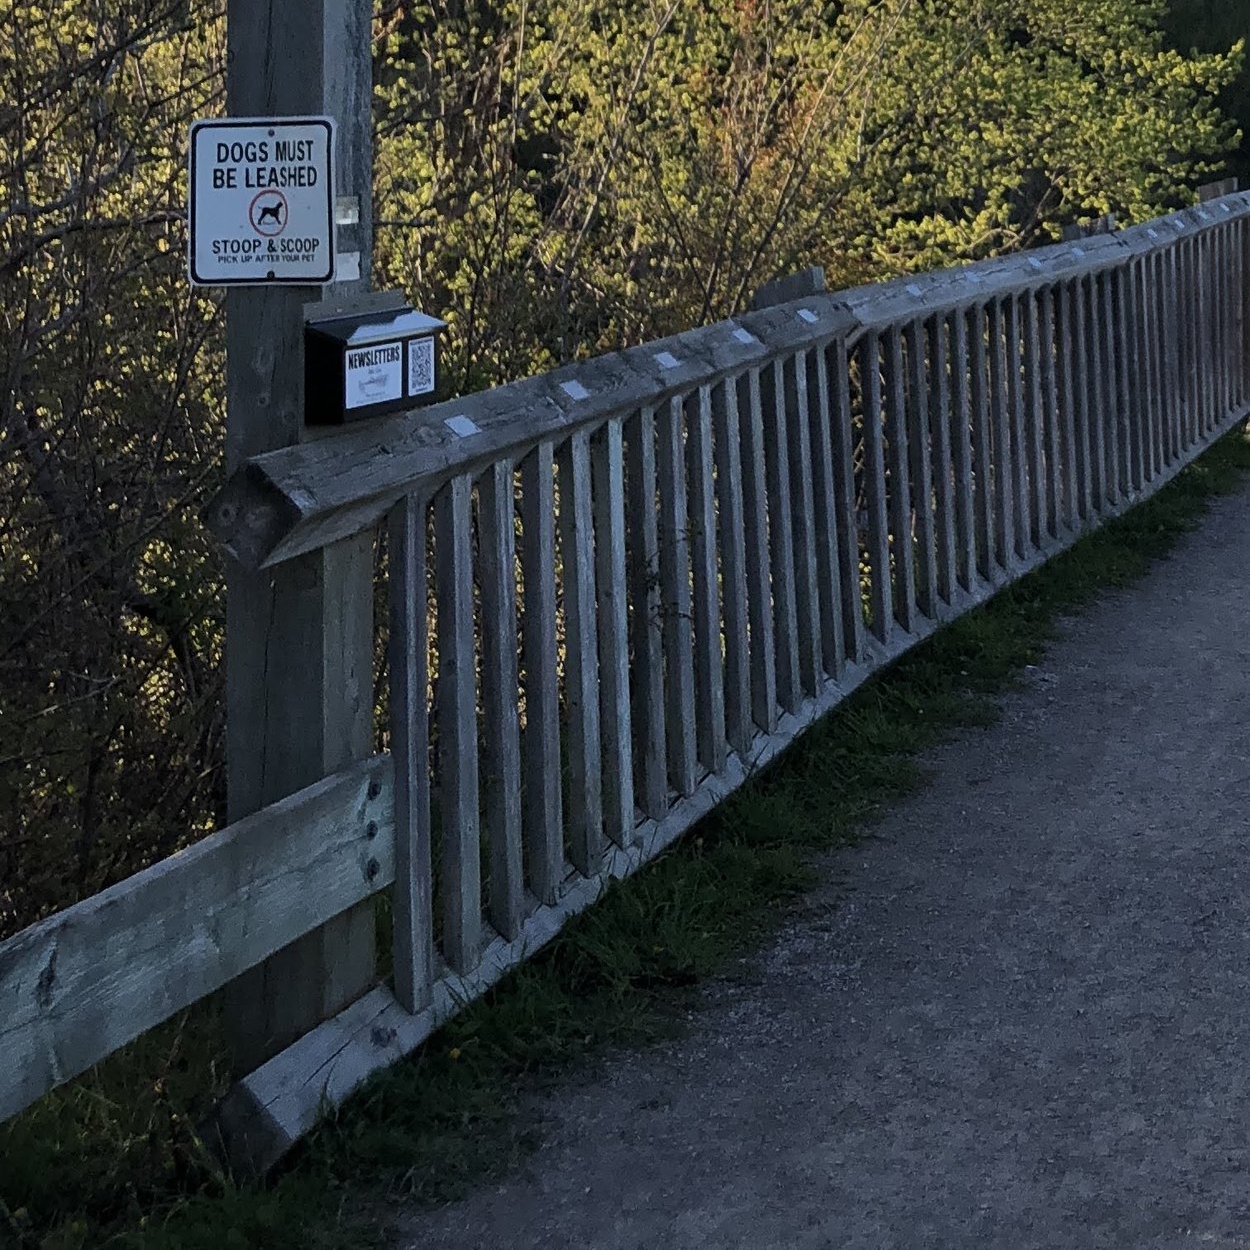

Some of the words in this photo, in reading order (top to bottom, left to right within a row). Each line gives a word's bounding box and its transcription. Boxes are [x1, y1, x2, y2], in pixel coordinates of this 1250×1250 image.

[217, 142, 269, 163] DOGS
[275, 140, 314, 161] MUST
[213, 168, 237, 189] BE
[245, 166, 317, 188] LEASHED
[212, 239, 262, 254] STOOP
[267, 239, 278, 253] &
[280, 238, 320, 253] SCOOP
[218, 255, 239, 264] PICK
[241, 255, 252, 263] UP
[255, 255, 280, 263] AFTER
[281, 254, 300, 263] YOUR
[301, 254, 315, 263] PET
[348, 345, 400, 371] NEWSLETTERS
